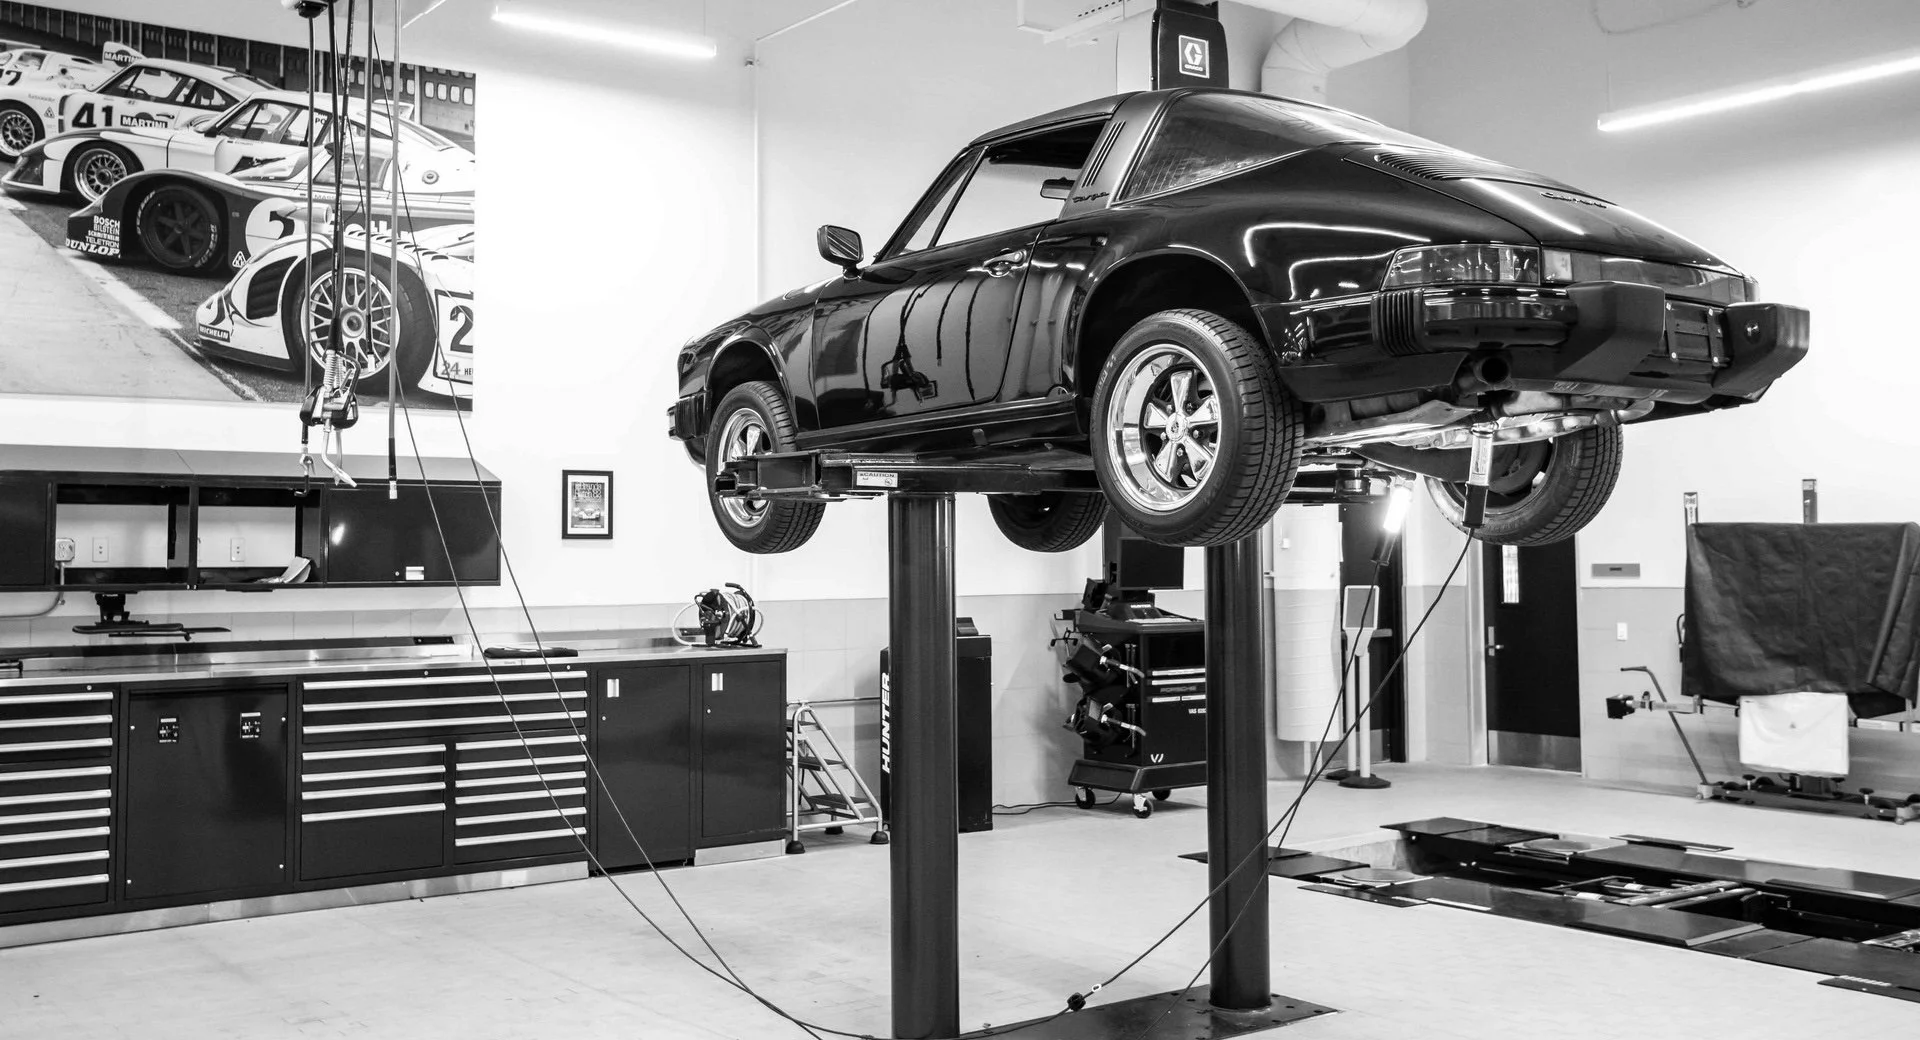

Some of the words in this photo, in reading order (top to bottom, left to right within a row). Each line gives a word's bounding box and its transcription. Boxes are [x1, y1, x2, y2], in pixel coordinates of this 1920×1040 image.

[71, 102, 113, 128] 41
[122, 116, 168, 128] MARTINI
[93, 215, 120, 228] BOSCH
[65, 237, 120, 256] DUNLOP
[440, 362, 461, 376] 24
[881, 672, 890, 774] HUNTER
